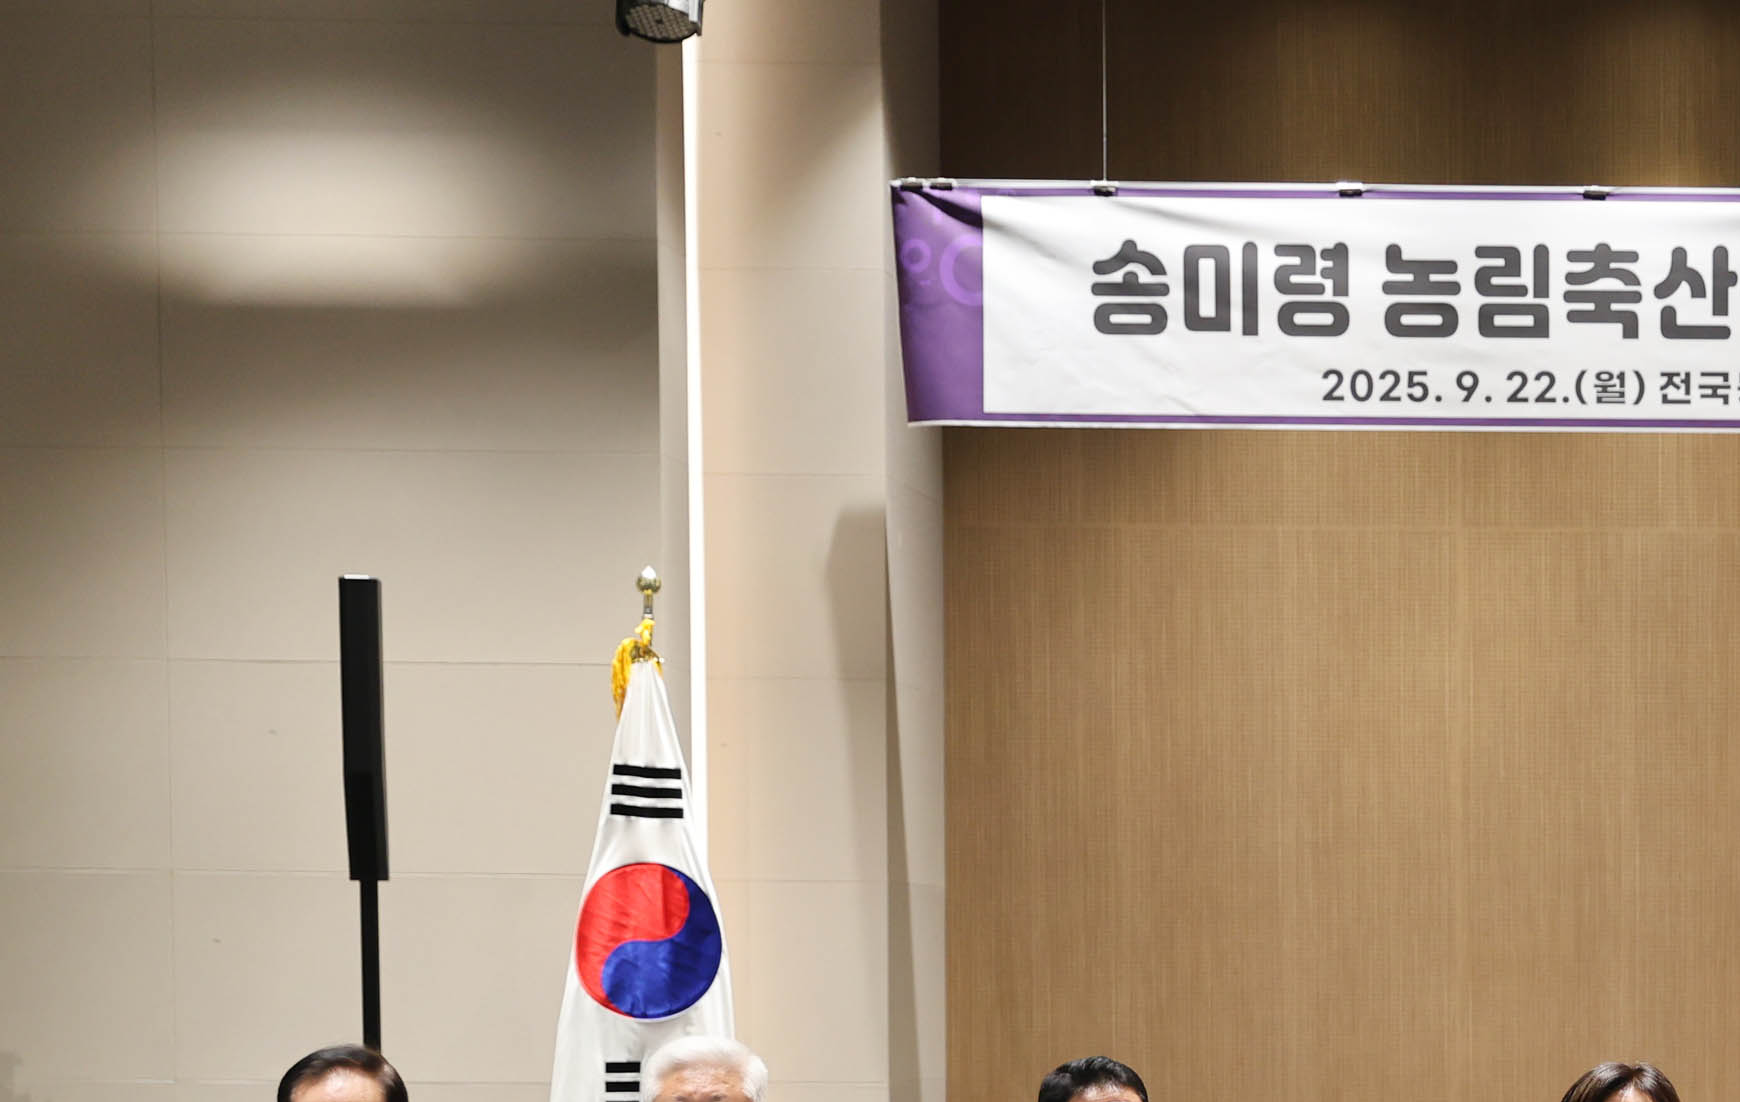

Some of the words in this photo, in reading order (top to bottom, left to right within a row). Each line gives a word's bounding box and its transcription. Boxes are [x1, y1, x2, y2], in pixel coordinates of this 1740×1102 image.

[1092, 240, 1349, 336] 송미령
[1322, 369, 1442, 403] 2025.
[1456, 370, 1492, 403] 9.
[1506, 370, 1646, 405] 22.(월)
